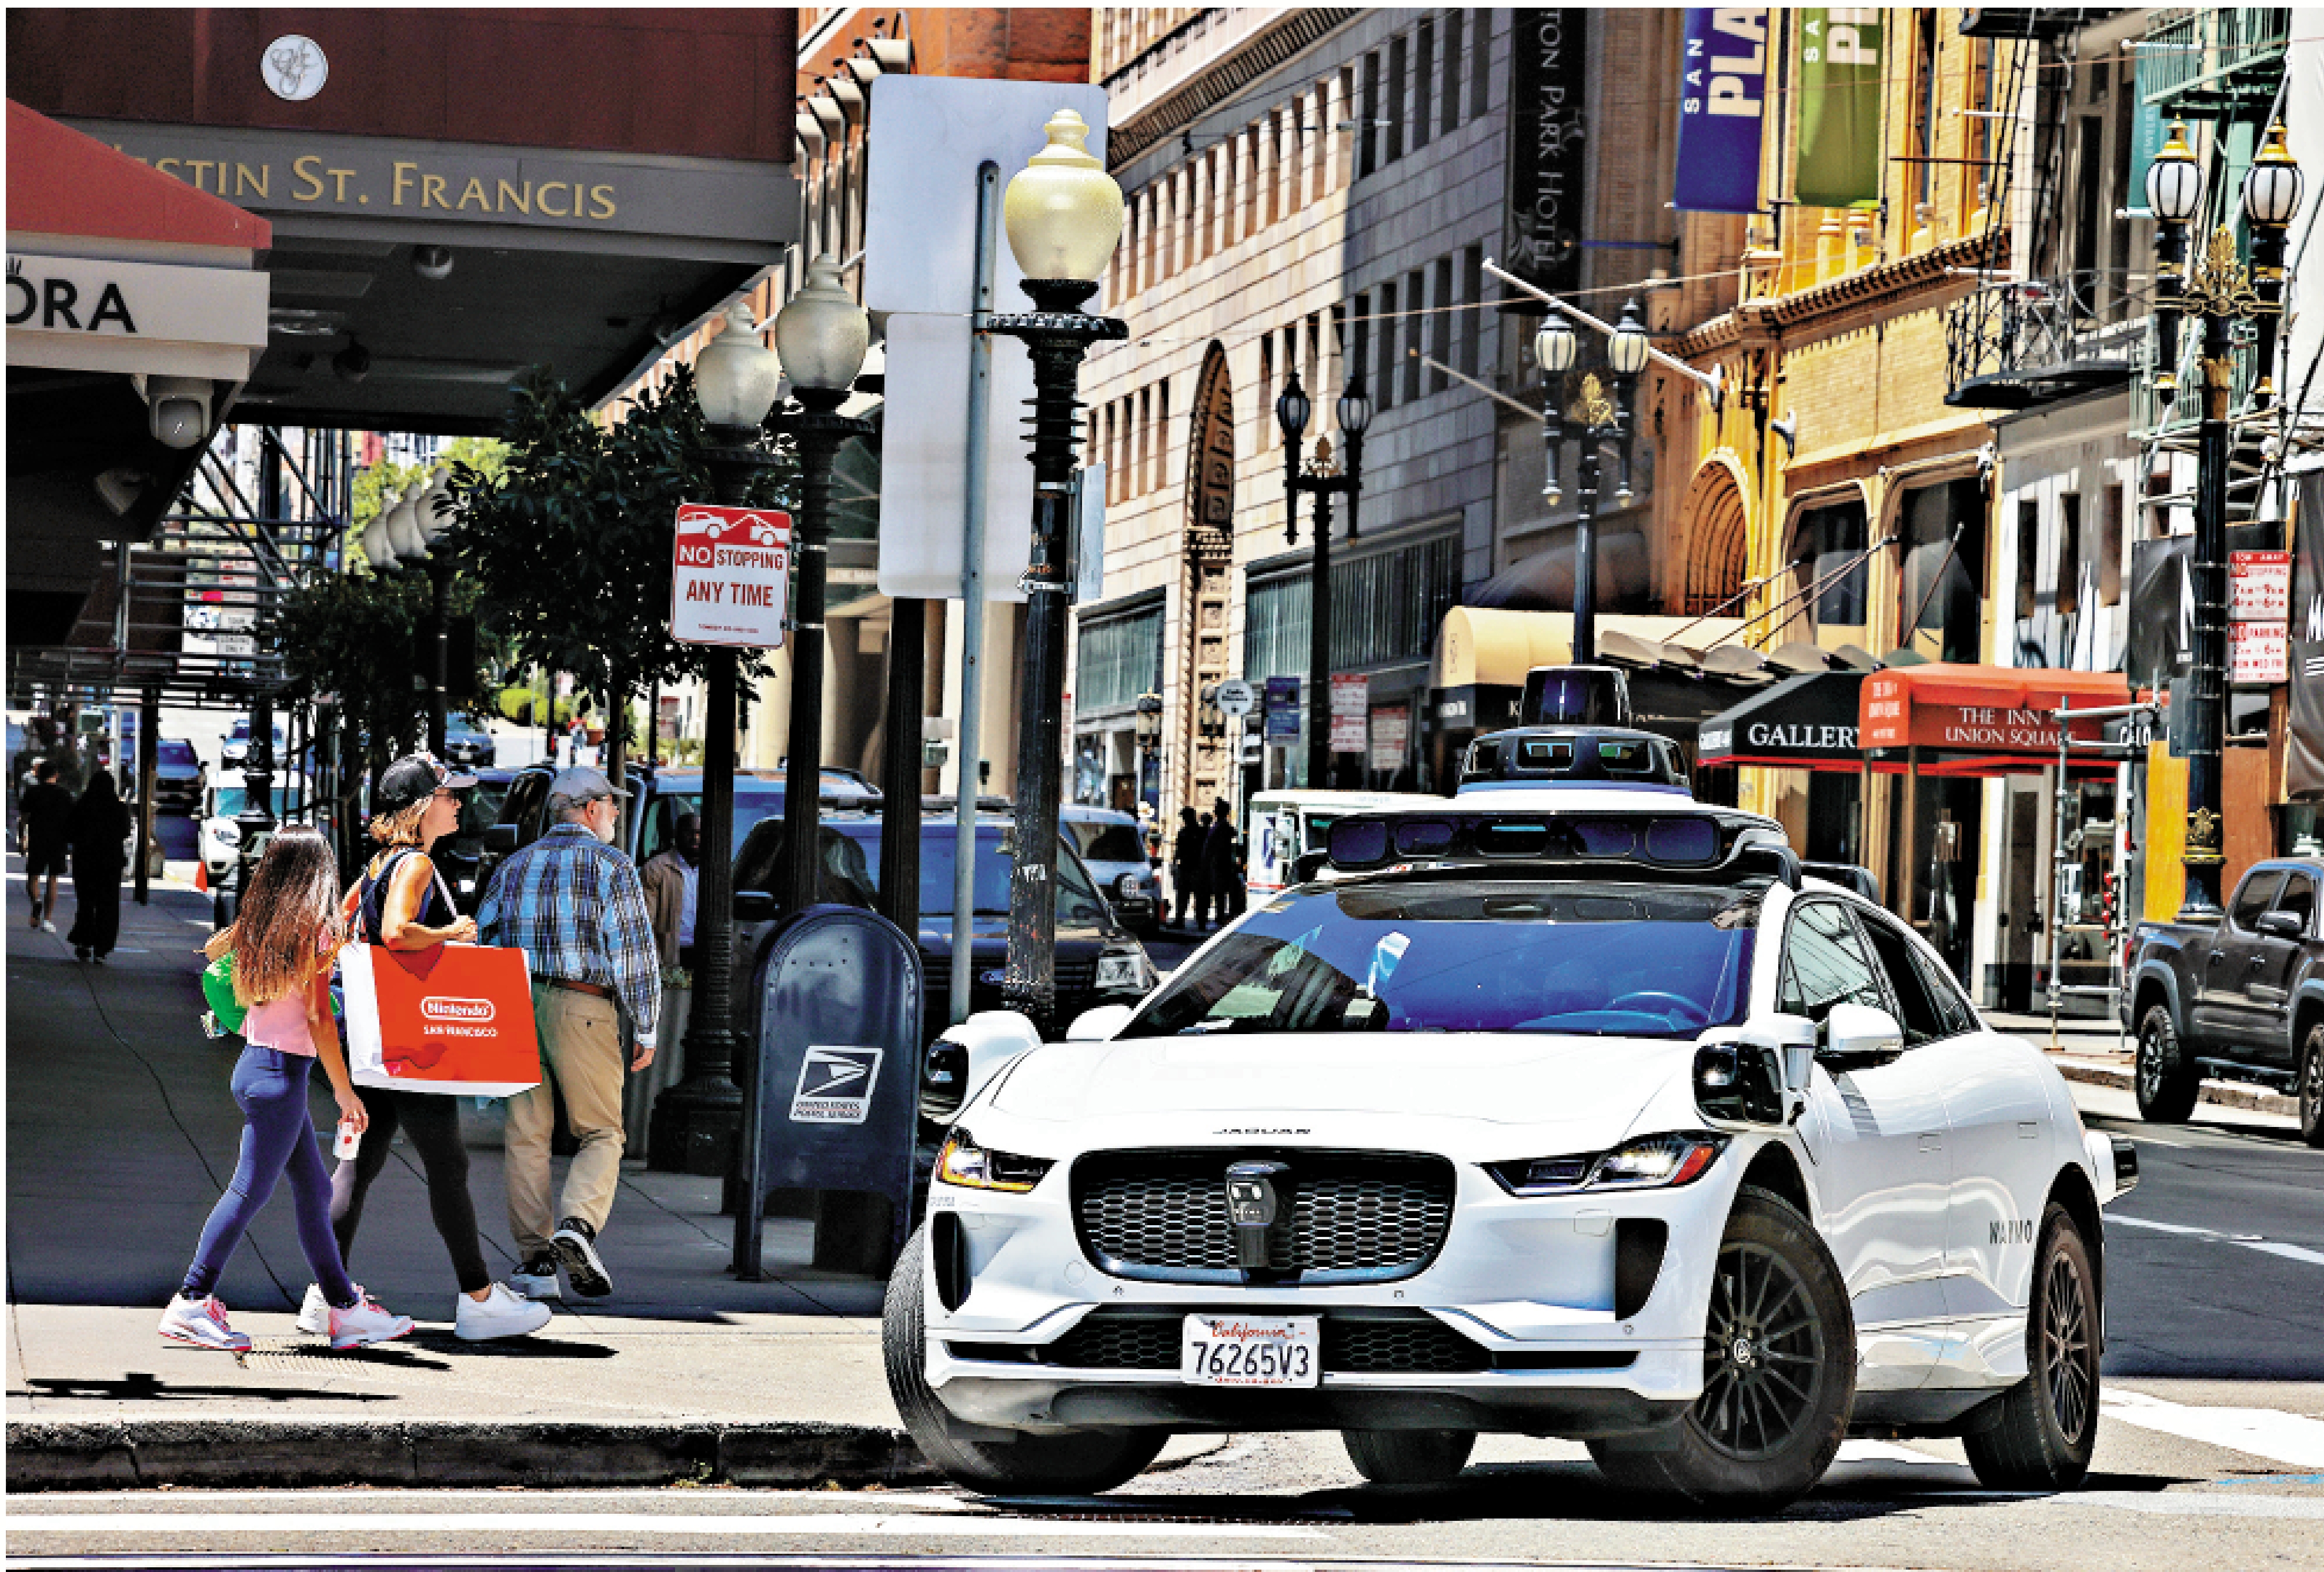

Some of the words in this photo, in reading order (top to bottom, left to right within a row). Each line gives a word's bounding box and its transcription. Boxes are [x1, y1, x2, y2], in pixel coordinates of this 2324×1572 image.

[1684, 39, 1704, 114] SAN
[1538, 86, 1565, 158] PARK
[114, 144, 270, 198] STIN
[390, 162, 617, 220] FRANCIS
[1534, 172, 1565, 268] HOTEL
[679, 544, 710, 563] NO
[716, 549, 783, 571] STOPPING
[686, 579, 724, 604] ANY
[730, 581, 773, 608] TIME
[1959, 707, 1995, 725] THE
[2006, 710, 2042, 727] INN
[1747, 721, 1860, 748] GALLER
[1945, 726, 2005, 744] UNION
[428, 1002, 489, 1016] Nintendo
[423, 1025, 445, 1035] SAN
[446, 1025, 499, 1037] FRANCISCO
[1212, 1320, 1295, 1342] California
[1191, 1341, 1309, 1377] 76265V3
